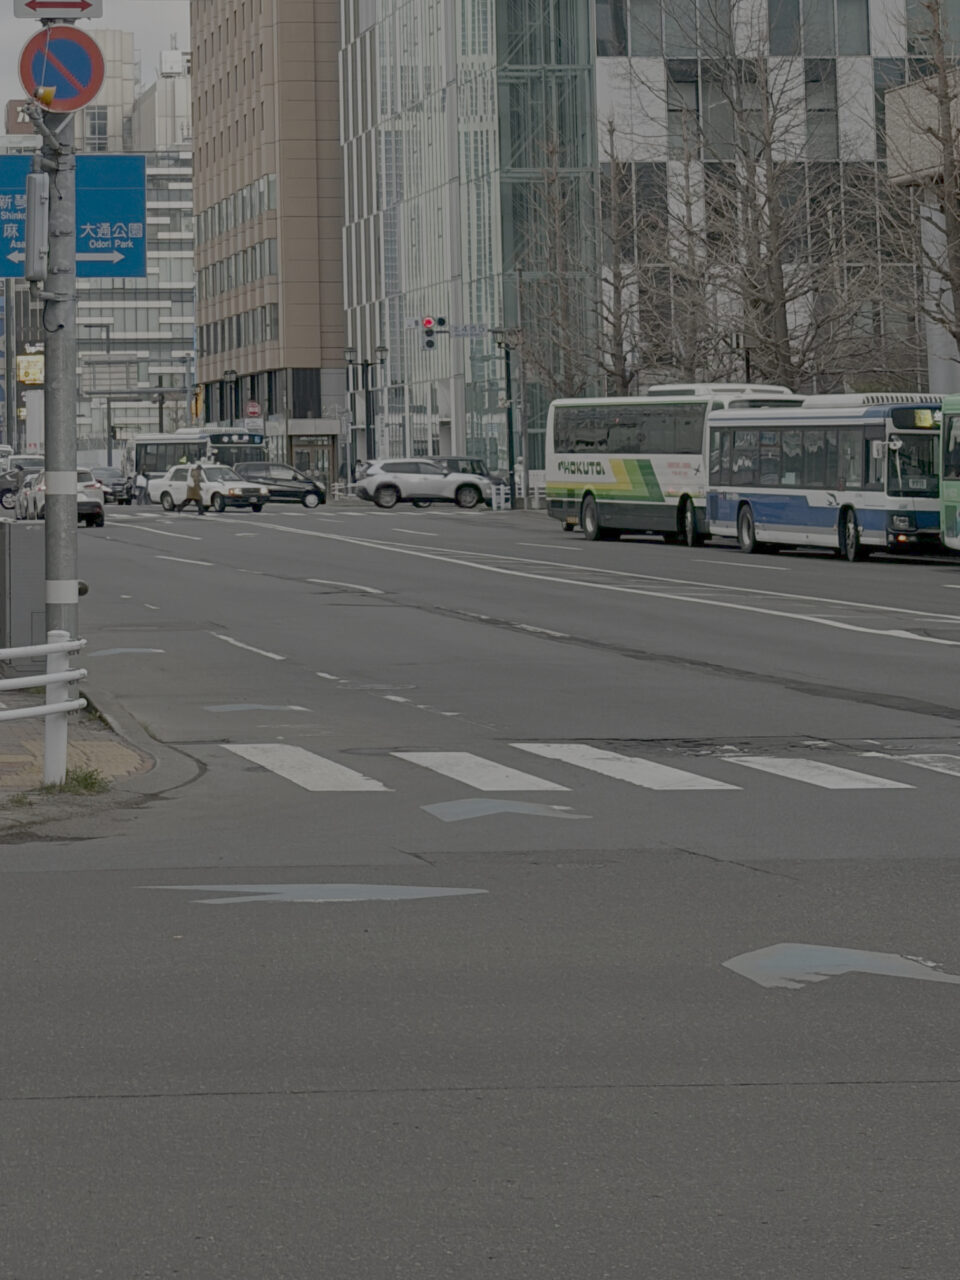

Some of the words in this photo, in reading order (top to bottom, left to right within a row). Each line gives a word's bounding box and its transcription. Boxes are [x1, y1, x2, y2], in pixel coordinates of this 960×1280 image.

[0, 211, 27, 220] Shinko
[79, 222, 143, 238] 大通公園
[9, 240, 26, 248] Asa
[89, 239, 111, 248] Odori
[114, 239, 134, 248] Park
